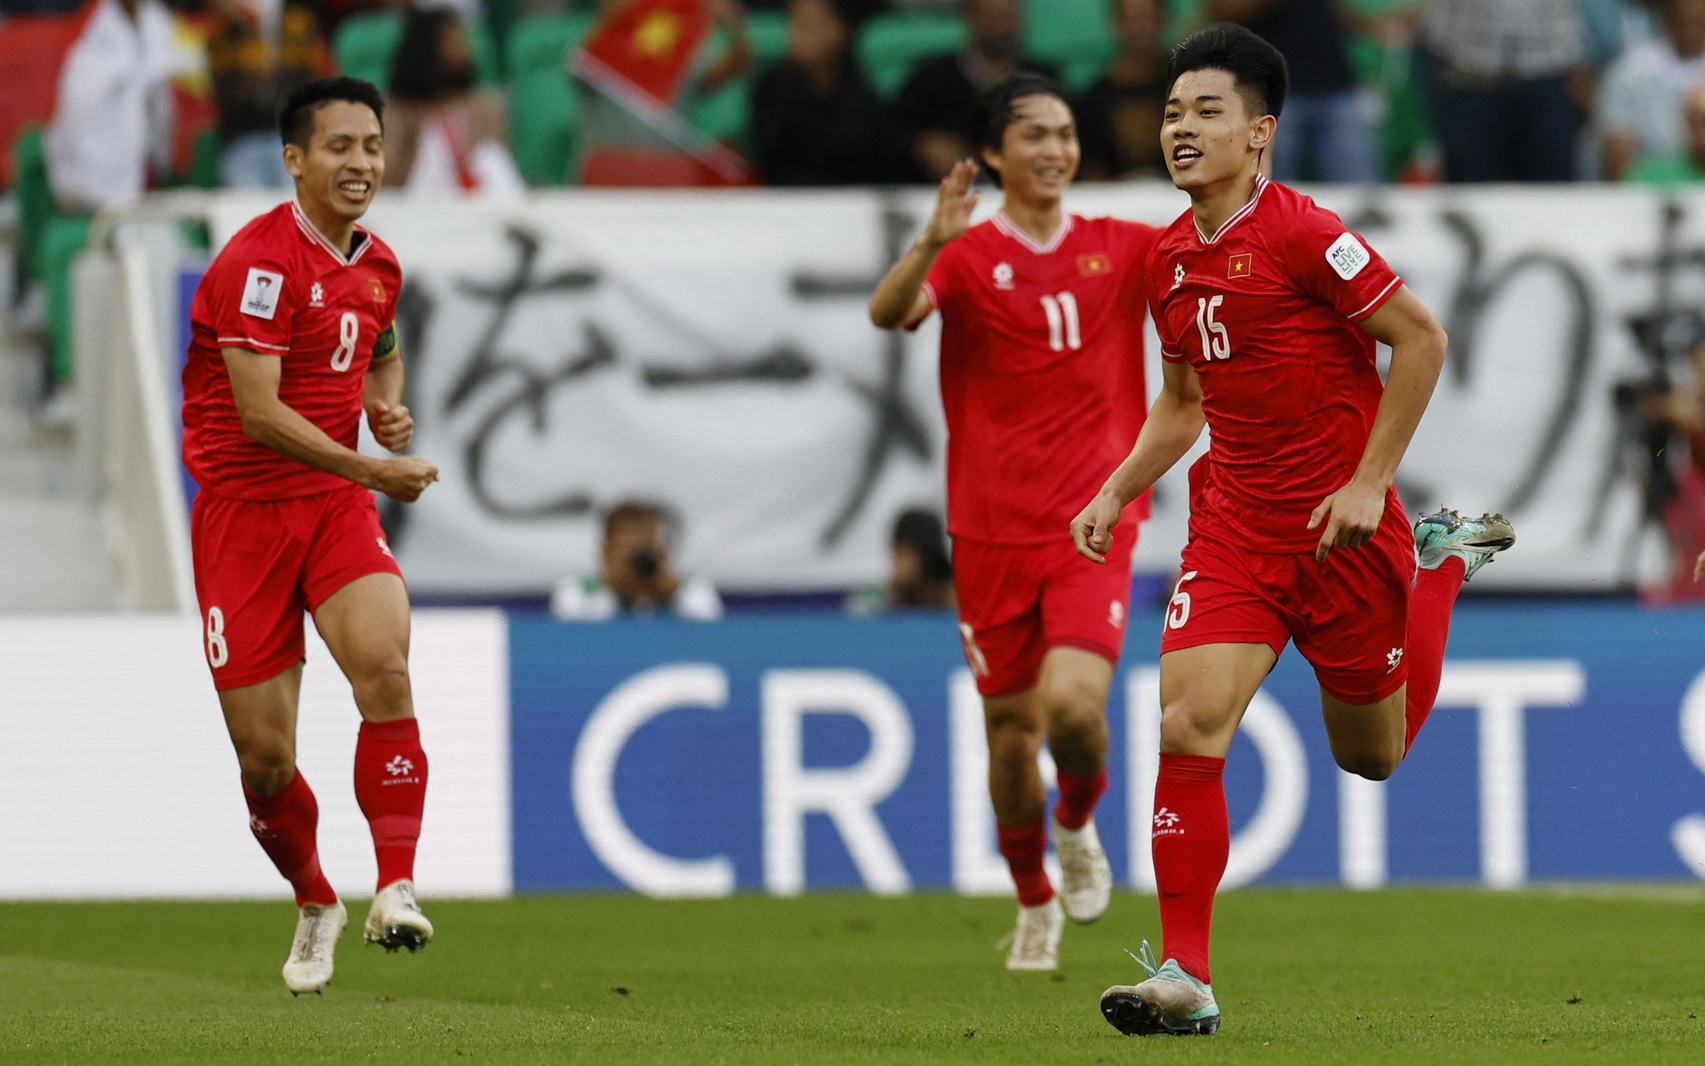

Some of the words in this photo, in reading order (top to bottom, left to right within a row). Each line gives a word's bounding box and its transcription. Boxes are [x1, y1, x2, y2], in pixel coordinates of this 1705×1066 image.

[1332, 245, 1345, 260] AFC
[1335, 244, 1358, 267] LIVE
[330, 311, 359, 372] 8
[1040, 290, 1082, 352] 11
[1196, 294, 1231, 361] 15
[207, 605, 229, 668] 8
